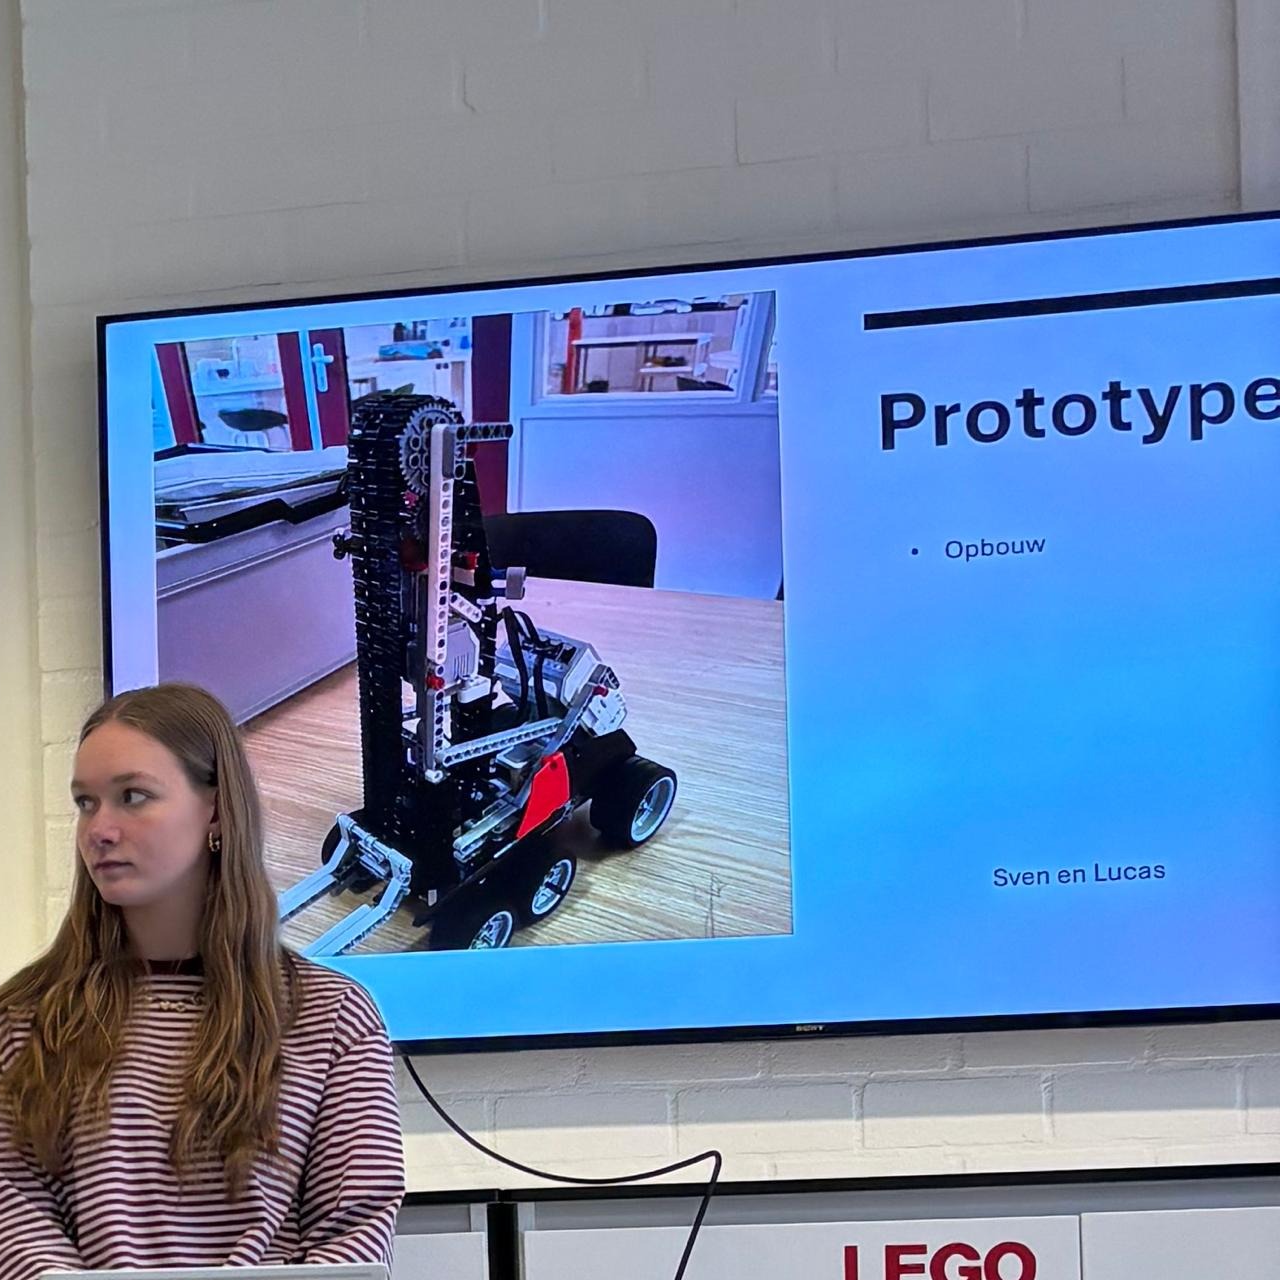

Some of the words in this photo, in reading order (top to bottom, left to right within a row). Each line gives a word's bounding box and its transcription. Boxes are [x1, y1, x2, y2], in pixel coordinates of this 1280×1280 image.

[880, 377, 1280, 450] Prototype
[945, 537, 1046, 562] Opbouw
[993, 867, 1050, 887] Sven
[1057, 868, 1086, 884] en
[1094, 863, 1166, 882] Lucas
